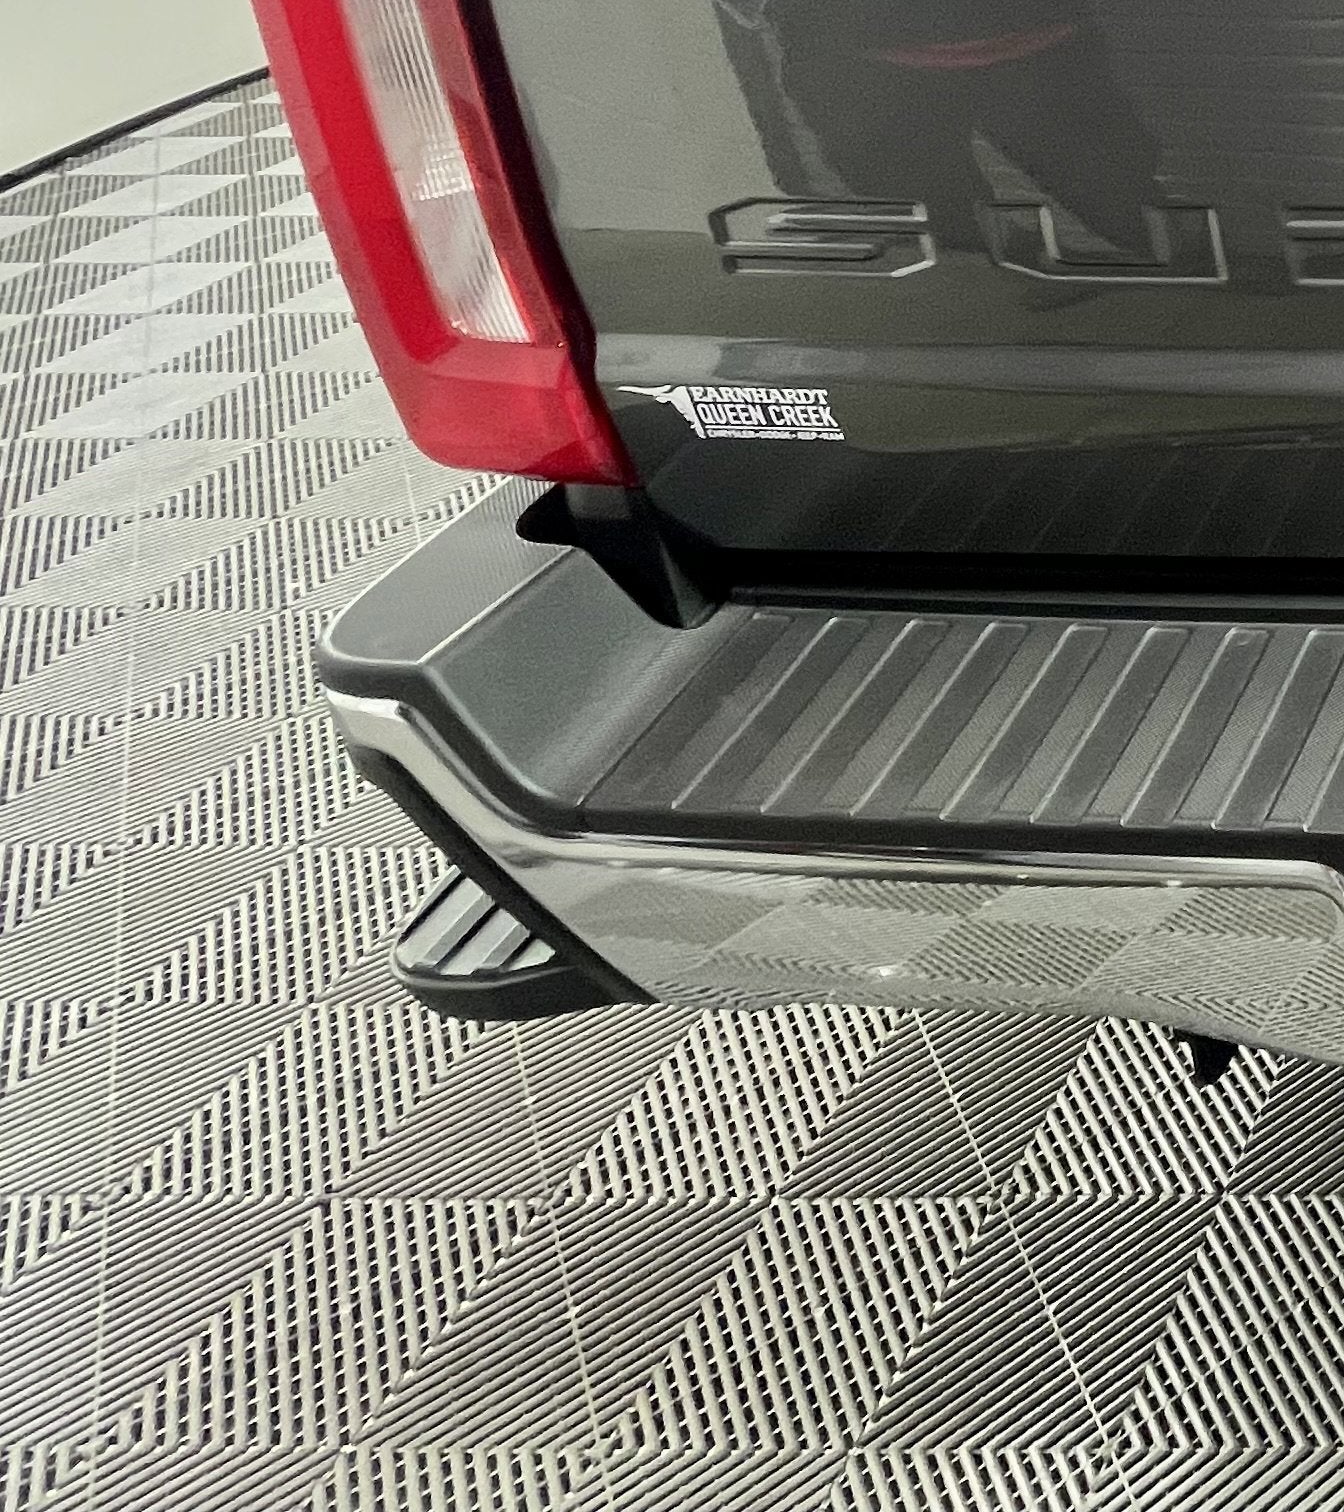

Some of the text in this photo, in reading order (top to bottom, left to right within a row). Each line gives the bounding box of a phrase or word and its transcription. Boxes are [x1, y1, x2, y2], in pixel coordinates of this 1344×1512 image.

[690, 386, 828, 405] EARNHARDT
[696, 404, 839, 428] QUEEN CREEK
